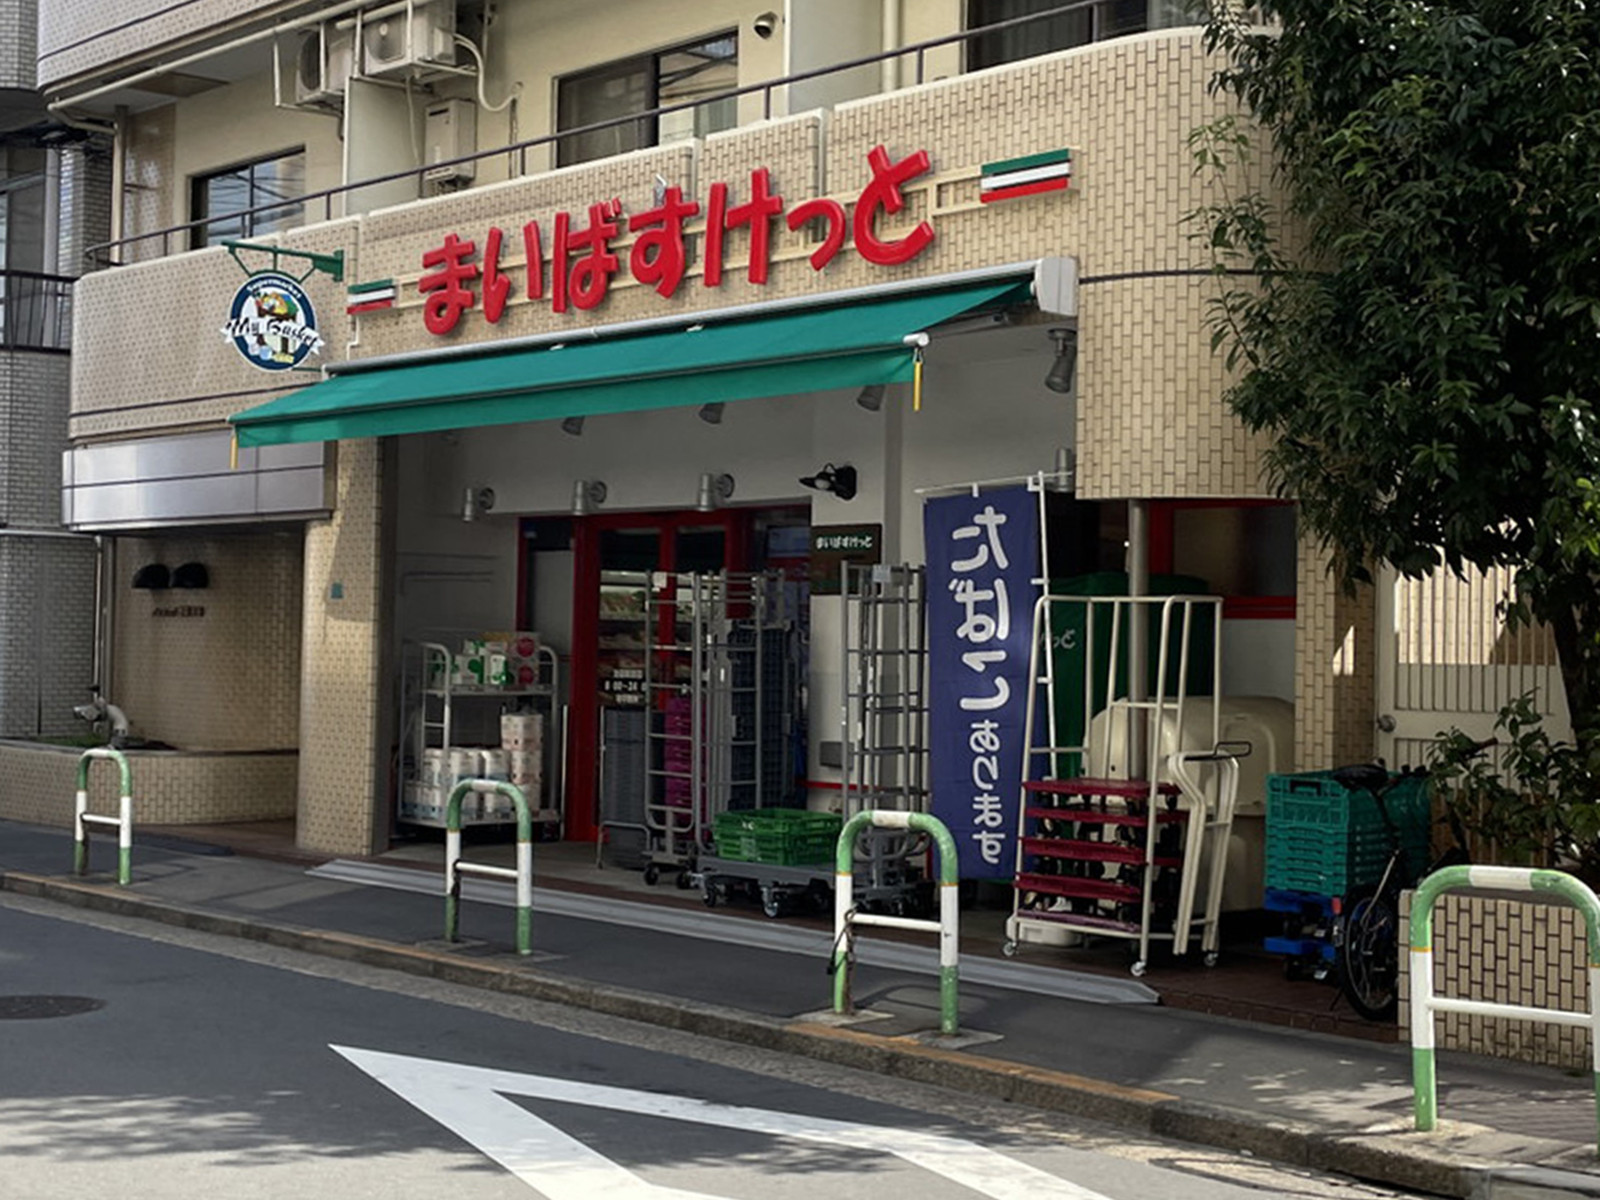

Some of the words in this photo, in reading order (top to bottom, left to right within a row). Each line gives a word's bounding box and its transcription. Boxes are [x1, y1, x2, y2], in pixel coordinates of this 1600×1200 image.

[418, 144, 935, 337] まいばすけっと
[225, 317, 260, 336] My
[267, 318, 318, 347] Basket
